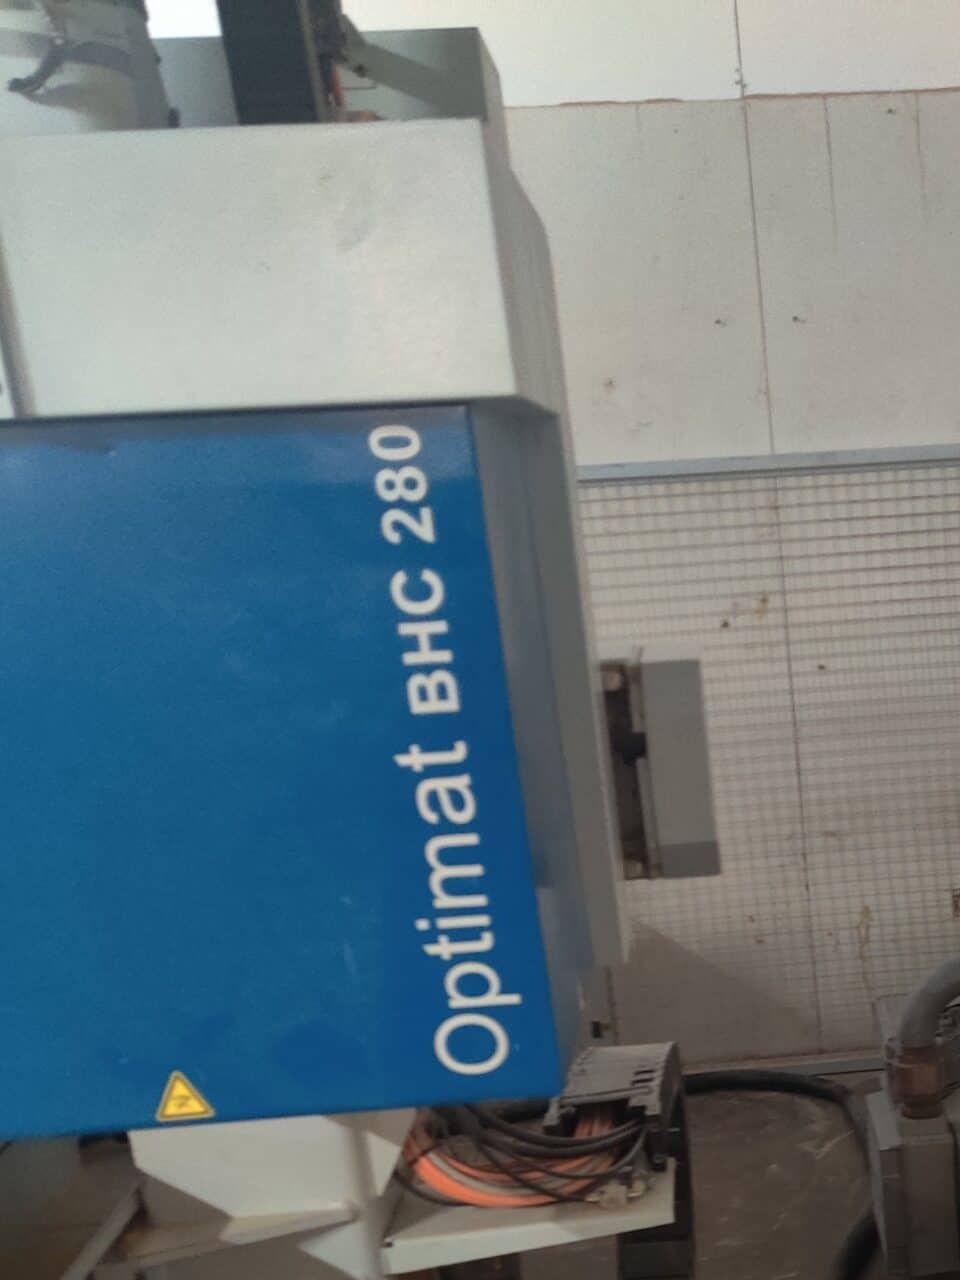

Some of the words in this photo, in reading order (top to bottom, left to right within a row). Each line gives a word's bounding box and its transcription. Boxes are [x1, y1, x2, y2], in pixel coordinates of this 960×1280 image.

[367, 423, 435, 544] 280
[390, 569, 460, 715] BHC
[394, 740, 521, 1075] Optimat
